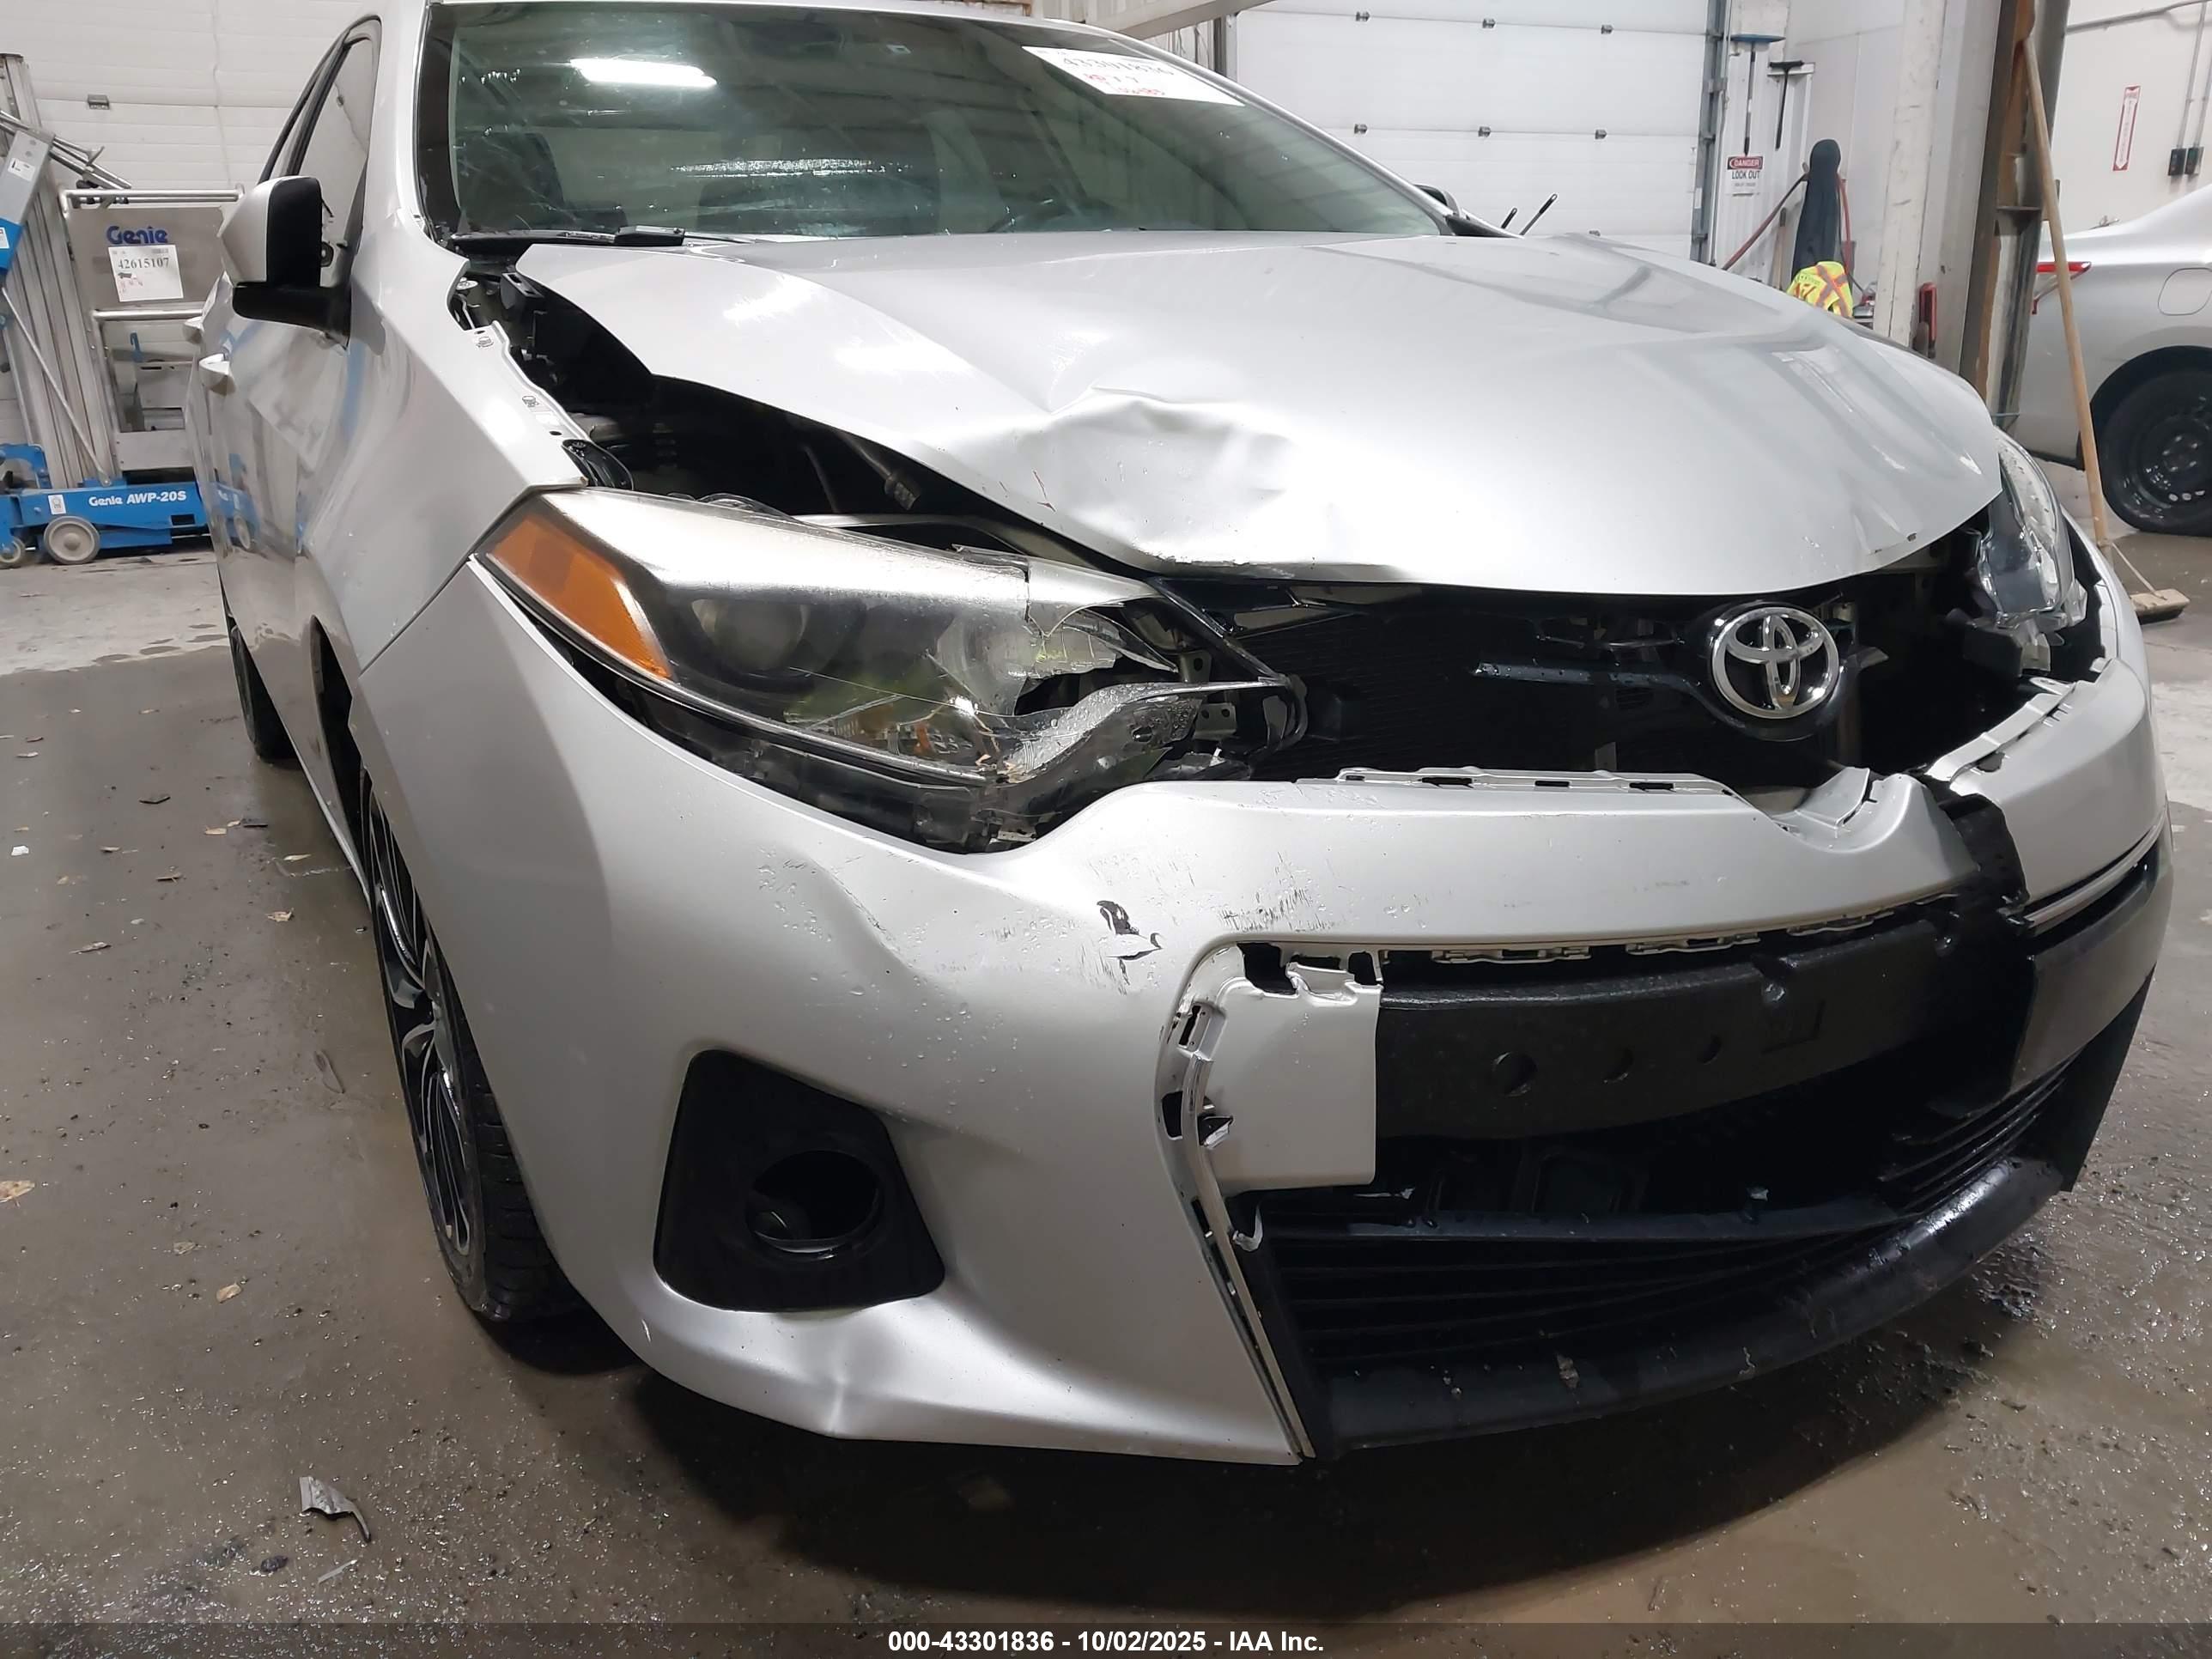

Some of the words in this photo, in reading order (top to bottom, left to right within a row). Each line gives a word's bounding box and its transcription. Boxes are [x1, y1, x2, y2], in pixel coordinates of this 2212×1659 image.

[1731, 170, 1747, 179] LOOK
[1748, 170, 1759, 179] OUT
[106, 225, 168, 245] Genie
[118, 257, 169, 269] 42615107
[88, 495, 123, 507] Genie
[126, 490, 187, 505] AWP-20S
